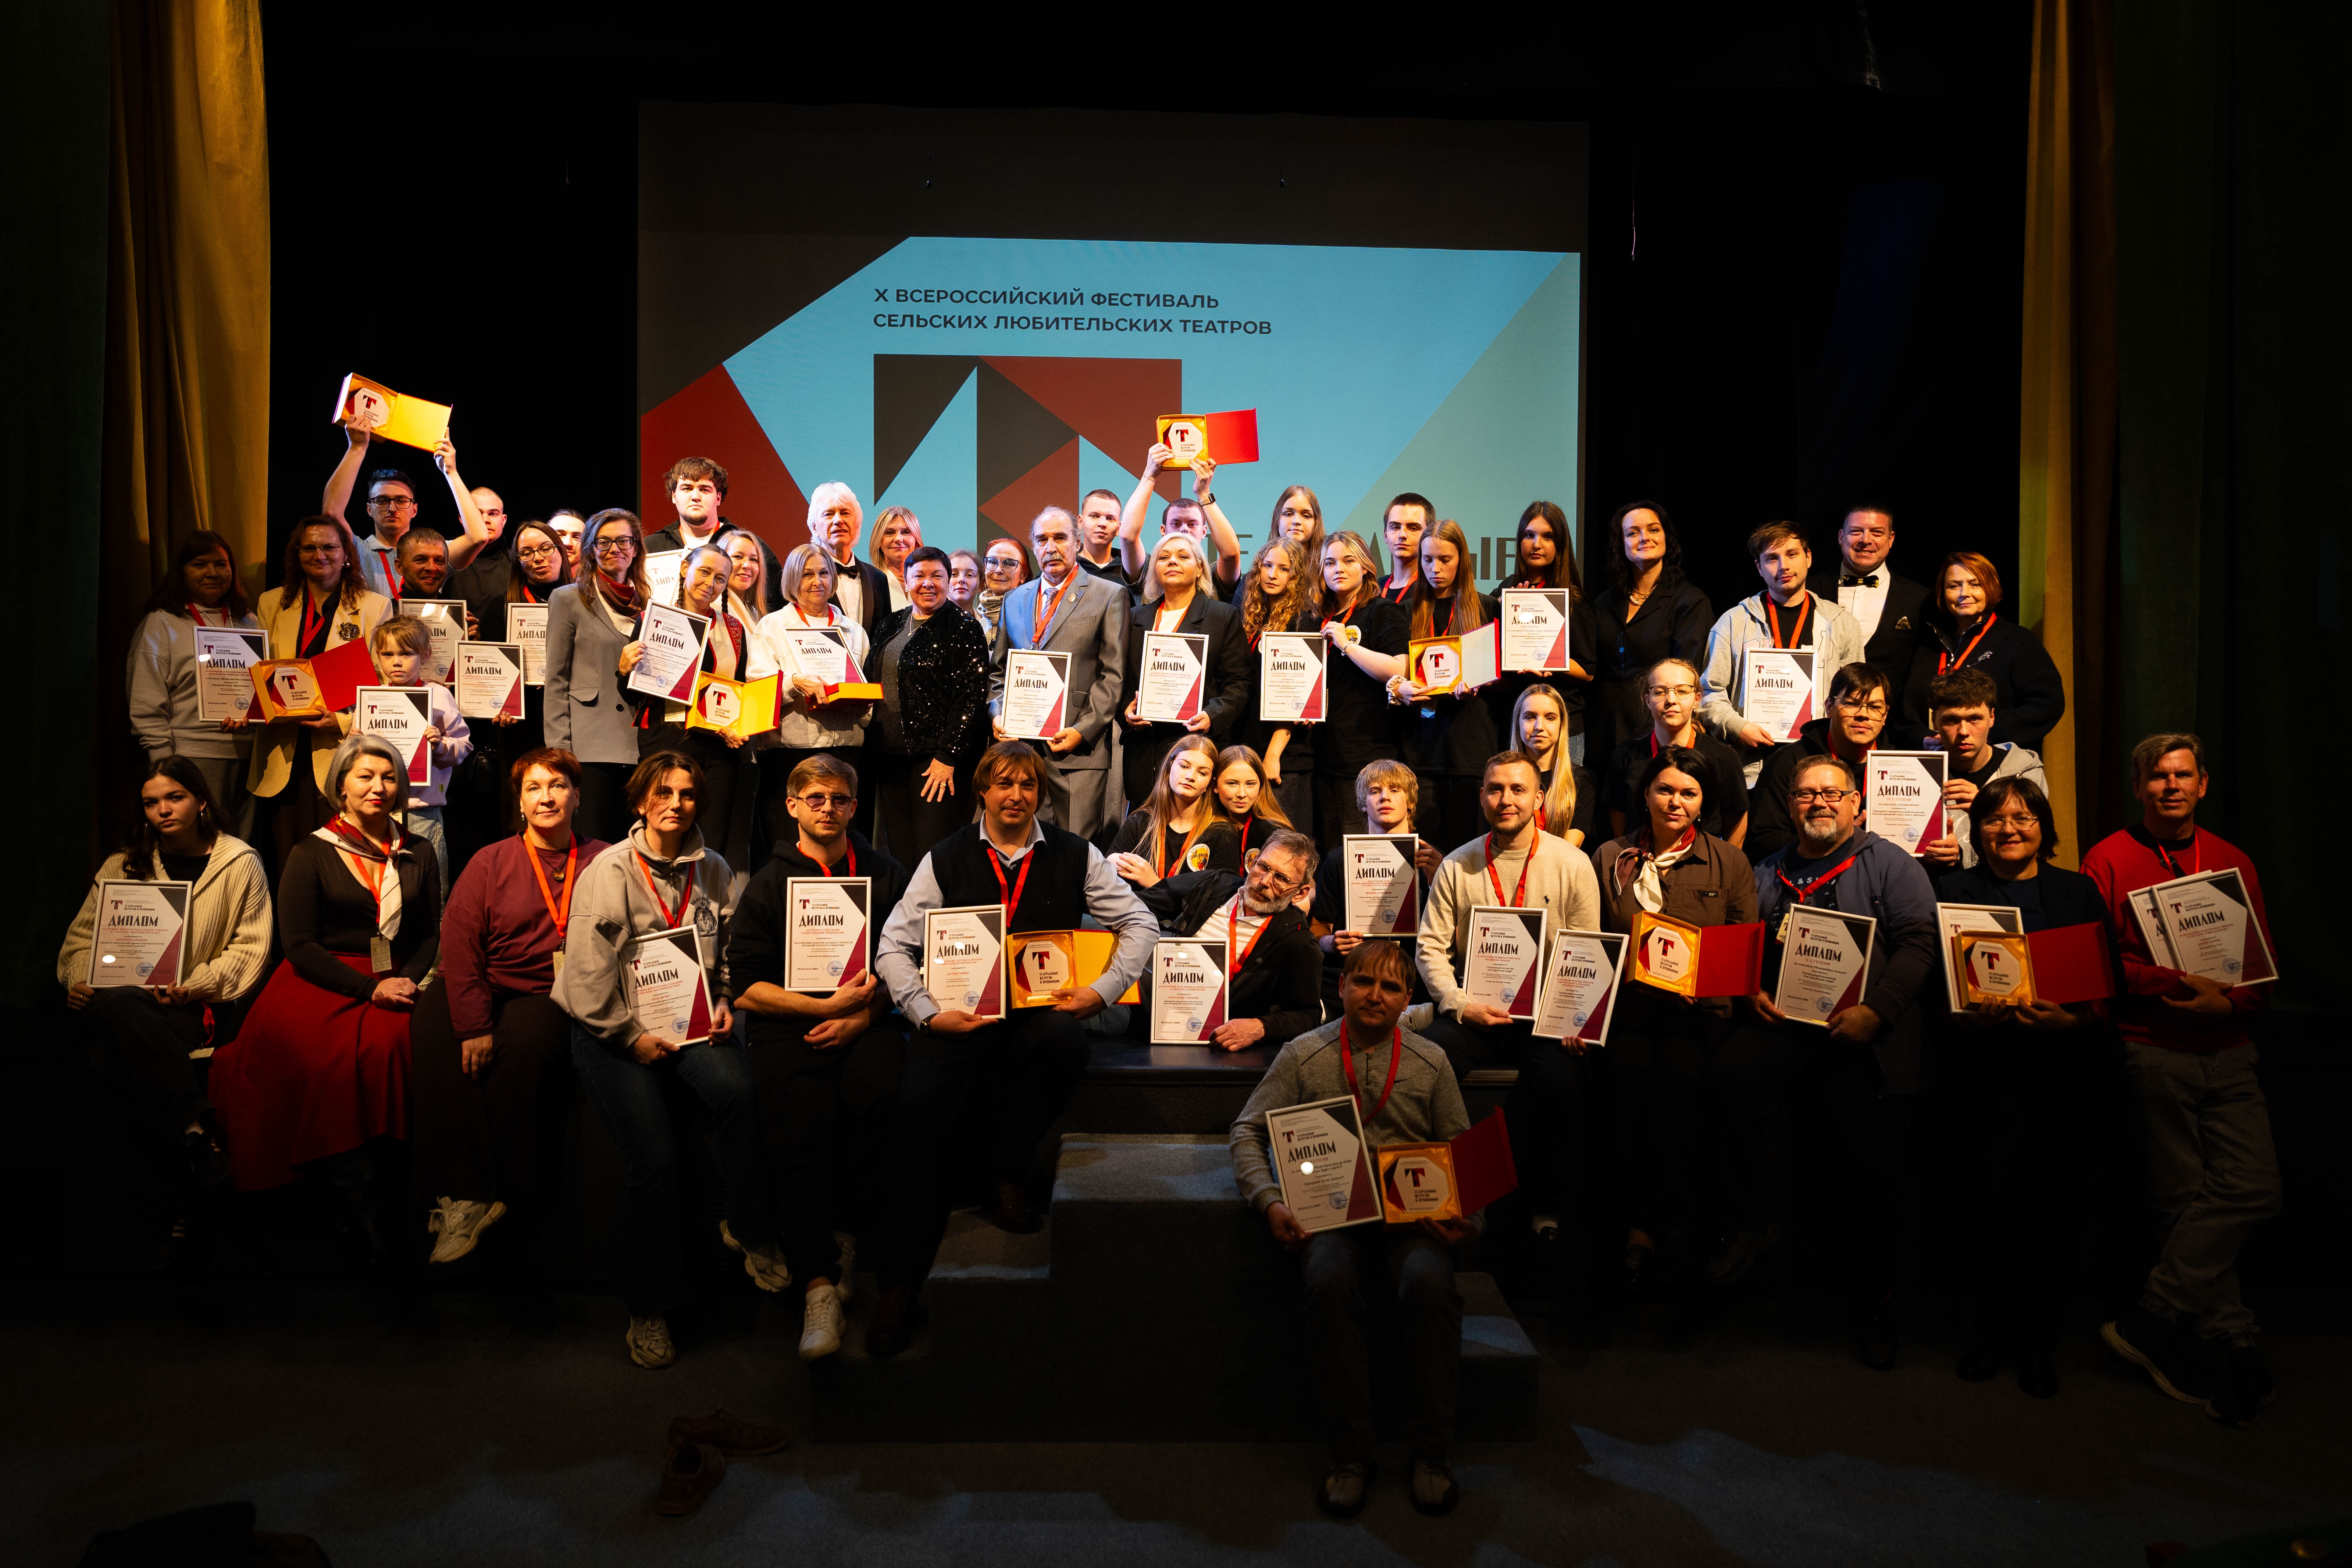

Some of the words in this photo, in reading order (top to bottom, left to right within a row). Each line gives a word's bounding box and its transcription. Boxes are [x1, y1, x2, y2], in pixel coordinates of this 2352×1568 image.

[896, 287, 1084, 306] ВСЕРОССИЙСКИЙ
[1091, 293, 1219, 308] ФЕСТИВАЛЬ
[874, 314, 988, 329] СЕЛЬСКИХ
[994, 316, 1173, 332] ЛЮБИТЕЛЬСКИХ
[1179, 320, 1272, 335] ТЕАТРОВ
[517, 630, 545, 639] ДИПЛО
[650, 632, 684, 649] ДИПЛОМ
[206, 659, 245, 669] ДИПЛОМ
[466, 666, 501, 674] ДИПЛОМ
[1151, 660, 1184, 671] ДИПЛОМ
[1271, 661, 1305, 671] ДИПЛОМ
[1014, 678, 1047, 689] ДИПЛОМ
[1755, 678, 1792, 688] ДИПЛОМ
[368, 719, 407, 730] ДИПЛОМ
[1878, 784, 1920, 797] ДИПЛОМ
[1355, 867, 1395, 879] ДИПЛОМ
[108, 914, 158, 927] ДИПЛОМ
[799, 914, 843, 927] ДИПЛОМ
[2178, 910, 2224, 932] ДИПЛОМ
[1478, 942, 1518, 955] ДИПЛОМ
[1795, 943, 1842, 962] ДИПЛОМ
[635, 968, 678, 989] ДИПЛОМ
[1163, 972, 1204, 984] ДИПЛОМ
[1557, 965, 1596, 979] ДИПЛОМ
[1289, 1141, 1336, 1163] ДИПЛОМ
